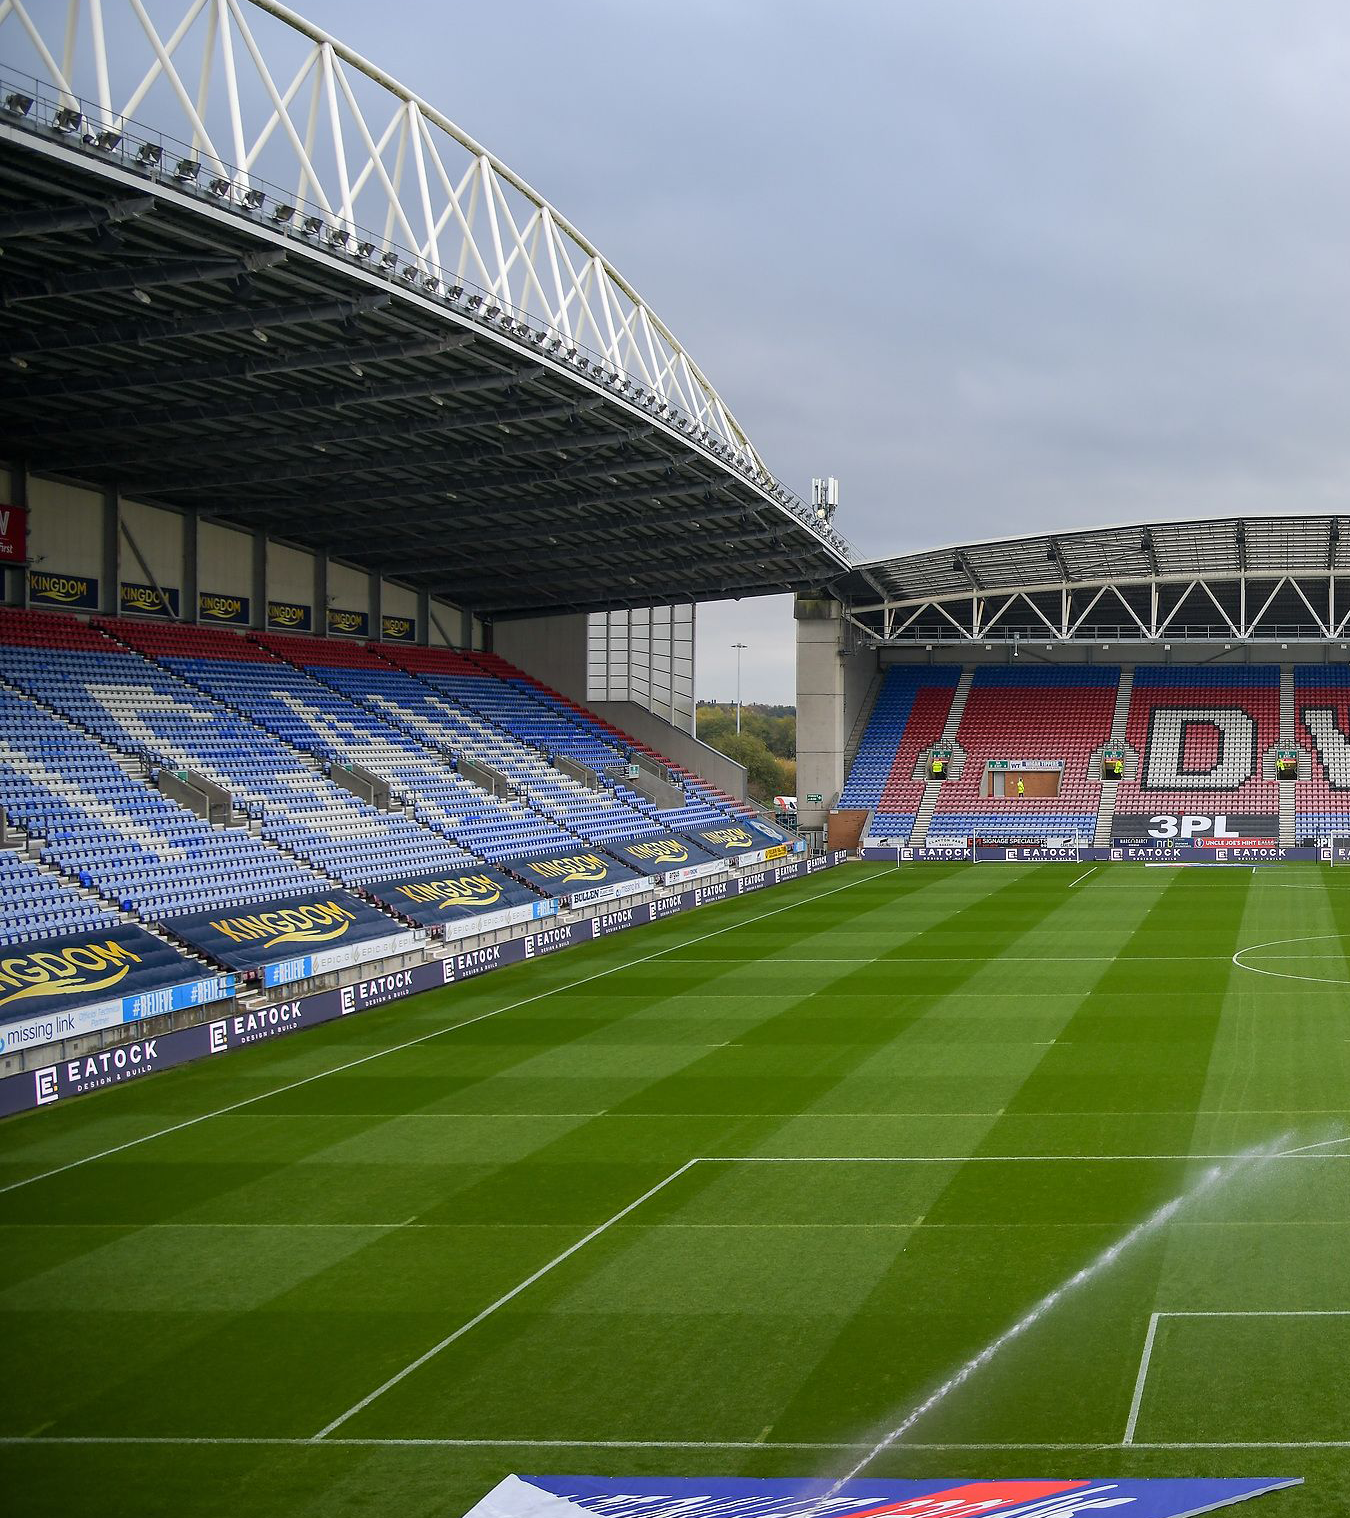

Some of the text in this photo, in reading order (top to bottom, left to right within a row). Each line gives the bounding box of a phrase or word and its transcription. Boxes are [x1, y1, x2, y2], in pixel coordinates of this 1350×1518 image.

[31, 575, 87, 596] KINGDOM
[200, 596, 241, 612] KINGDOM
[268, 606, 304, 620] KINGDOM
[1147, 815, 1240, 838] 3PL
[624, 839, 689, 860] KINGDOM
[919, 848, 971, 856] EATOCK
[1023, 848, 1076, 856] EATOCK
[1157, 838, 1173, 847] nrb
[526, 853, 609, 878] KINGDOM
[781, 864, 799, 876] EATOCK
[812, 856, 828, 867] EATOCK
[395, 874, 503, 903] KINGDOM
[702, 882, 727, 897] EATOCK
[744, 873, 764, 886] EATOCK
[573, 889, 600, 904] BULLEN
[657, 894, 682, 911] EATOCK
[209, 901, 356, 943] KINGDOM
[602, 910, 633, 928] EATOCK
[537, 926, 572, 946] EATOCK
[458, 945, 501, 969] EATOCK
[273, 959, 305, 984] #BELIEVE
[360, 970, 413, 999] EATOCK
[133, 989, 174, 1017] #BELIEVE
[365, 997, 382, 1007] DESIGN
[394, 989, 410, 998] BUILD
[234, 1001, 302, 1034] EATOCK
[7, 1013, 75, 1045] missing link
[241, 1031, 268, 1043] DESIGN
[278, 1022, 298, 1033] BUILD
[68, 1040, 158, 1082] EATOCK
[77, 1076, 112, 1092] DESIGN
[126, 1065, 152, 1077] BUILD
